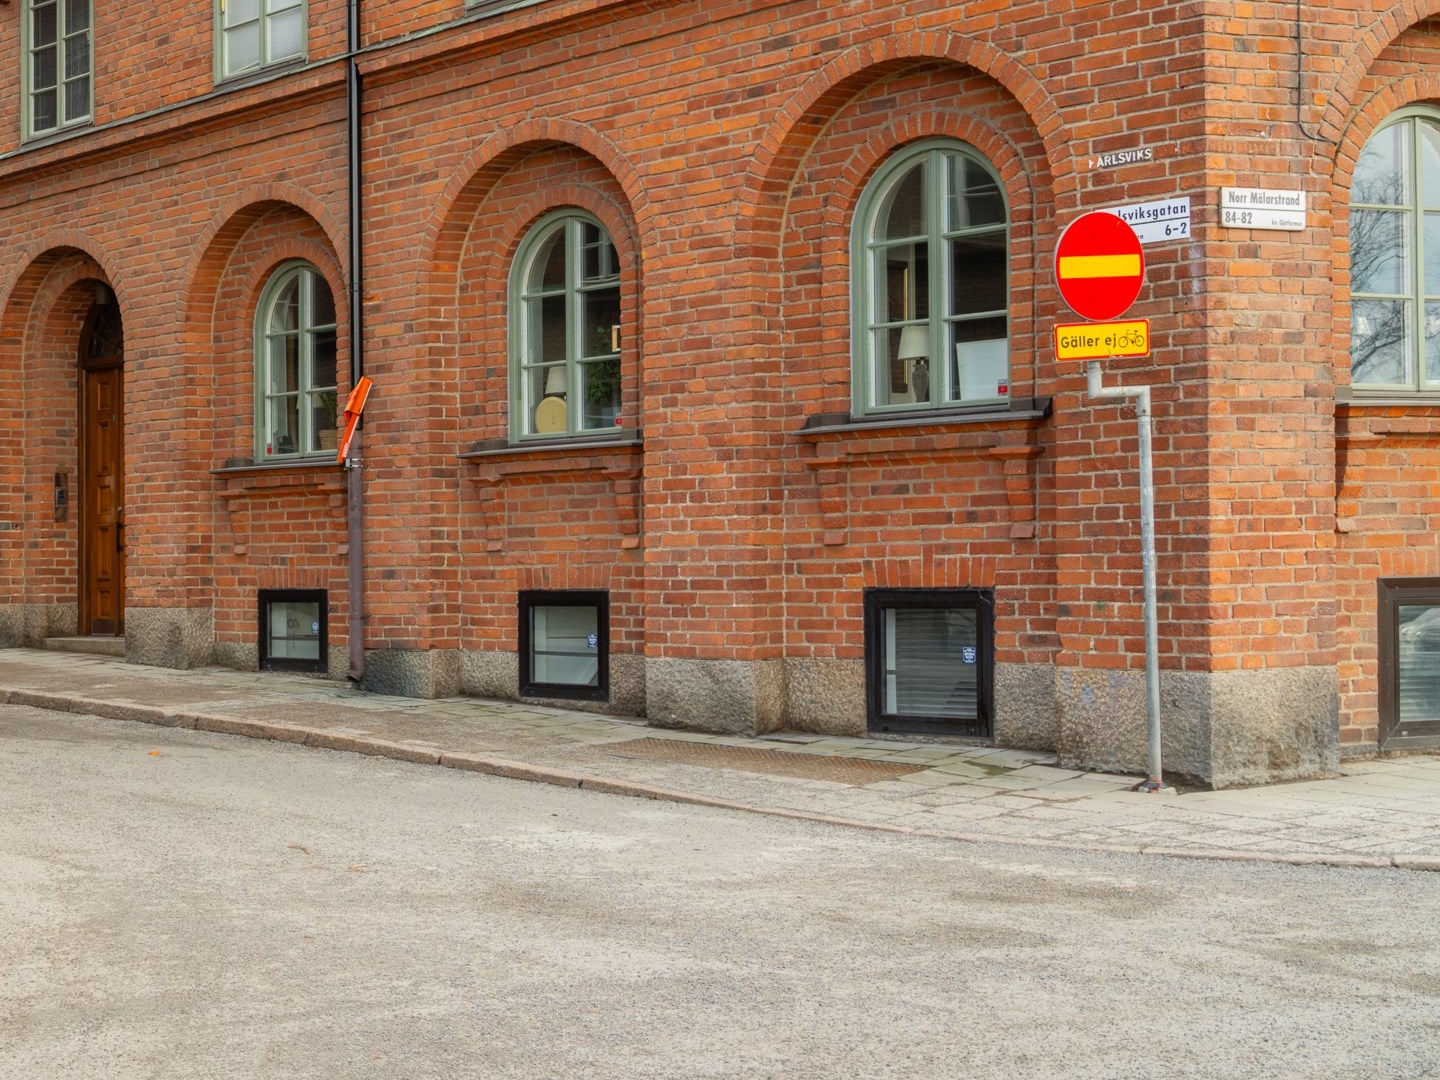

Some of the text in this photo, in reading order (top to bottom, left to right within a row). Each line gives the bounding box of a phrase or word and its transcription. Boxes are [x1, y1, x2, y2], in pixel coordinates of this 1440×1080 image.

[1228, 190, 1301, 206] Norr Mälarstrand
[1118, 204, 1187, 220] lsviksgatan
[1224, 211, 1253, 225] 84-82
[1164, 221, 1188, 236] 6-2
[1060, 332, 1117, 349] Gäller ej
